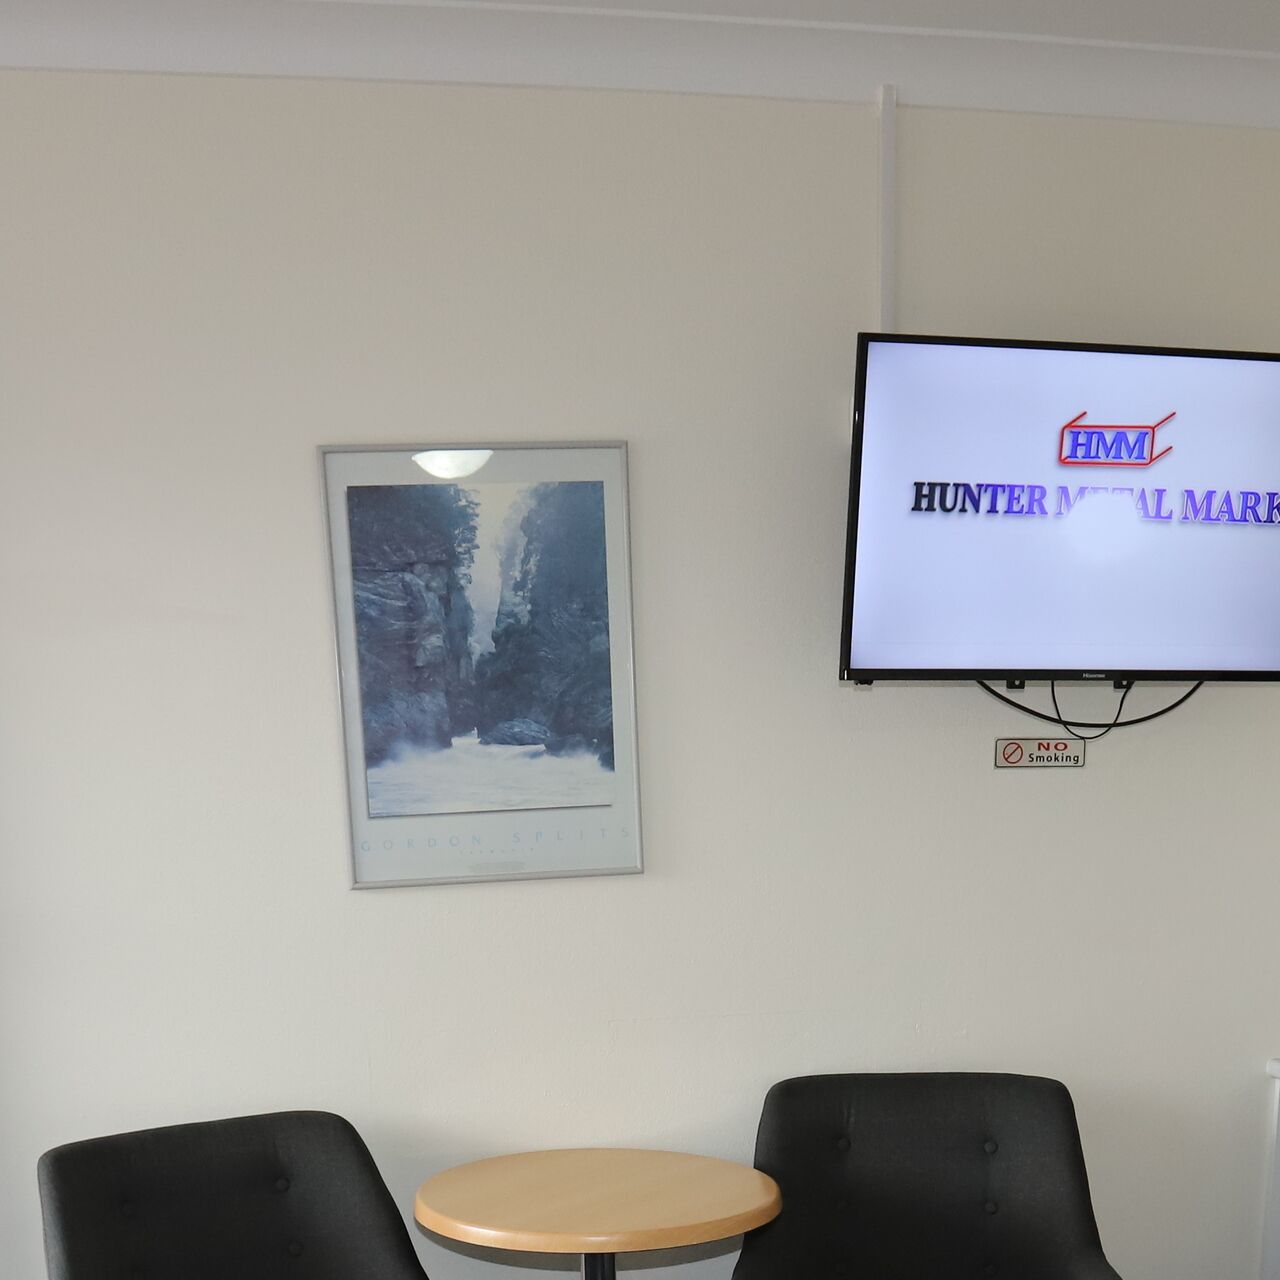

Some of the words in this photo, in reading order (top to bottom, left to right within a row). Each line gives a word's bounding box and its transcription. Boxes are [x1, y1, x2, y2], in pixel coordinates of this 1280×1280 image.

[1067, 430, 1149, 461] HMM
[911, 481, 1048, 517] HUNTER
[1054, 485, 1173, 521] MAL
[1028, 753, 1080, 765] Smoking
[1037, 741, 1068, 752] NO
[360, 831, 483, 853] GORDON
[512, 827, 631, 844] SPLITS
